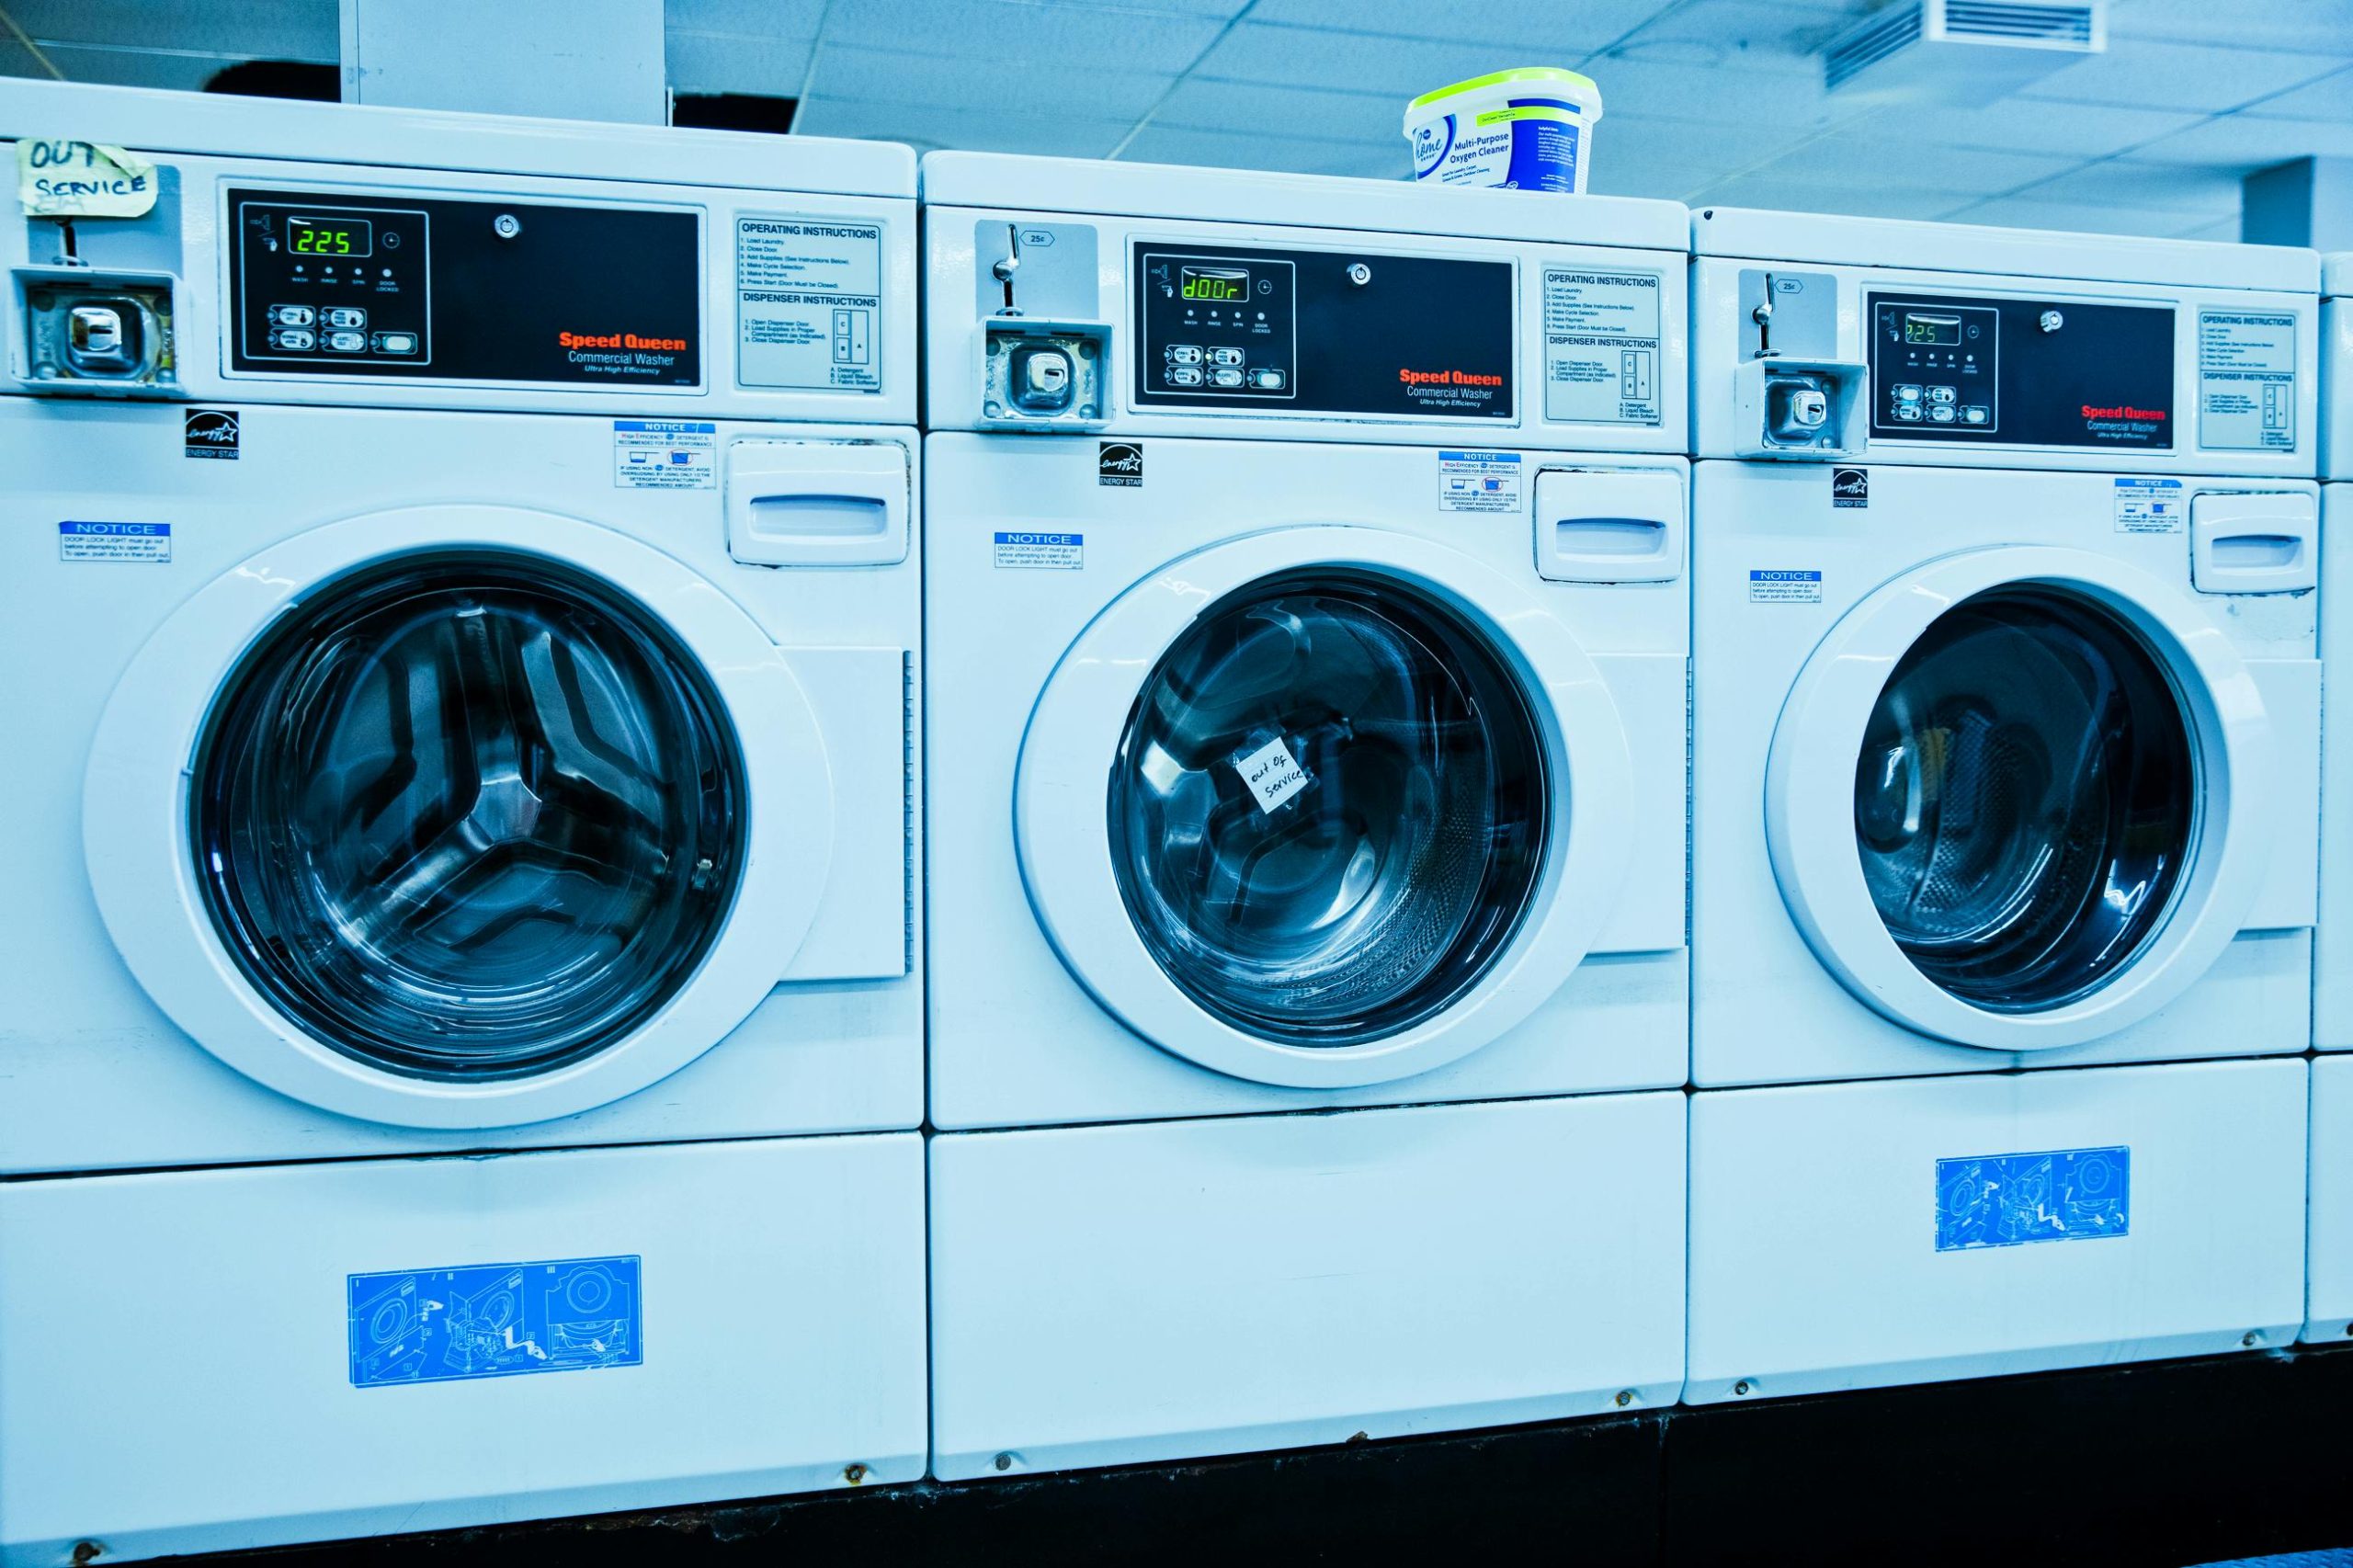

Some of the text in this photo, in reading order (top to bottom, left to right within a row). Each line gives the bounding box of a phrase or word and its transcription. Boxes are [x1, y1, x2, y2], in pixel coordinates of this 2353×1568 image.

[1455, 132, 1508, 151] Multi-Purpose
[30, 141, 95, 167] OUT
[1449, 144, 1508, 164] Oxygen Cleaner
[35, 176, 146, 196] SERVICE
[742, 223, 876, 239] OPERATING INSTRUCTIONS
[298, 231, 349, 254] 225
[1548, 274, 1655, 287] OPERATING INSTRUCTIONS
[744, 292, 876, 307] DISPENSER INSTRUCTIONS
[2203, 316, 2292, 326] OPERATING INSTRUCTIONS
[559, 332, 686, 350] Speed Queen
[1550, 336, 1656, 348] DISPENSER INSTRUCTIONS
[568, 351, 675, 366] Commercial Washer
[623, 367, 660, 375] Efficiency
[1400, 369, 1502, 386] Speed Queen
[1407, 386, 1493, 399] Commercial Washer
[1451, 400, 1481, 408] Efficiency
[2081, 405, 2165, 420] Speed Queen
[645, 423, 686, 431] NOTICE
[2087, 420, 2129, 431] Commercial
[187, 449, 216, 457] ENERGY
[76, 524, 155, 534] NOTICE
[1007, 534, 1072, 544] NOTICE
[1761, 572, 1813, 580] NOTICE
[1252, 763, 1268, 782] out
